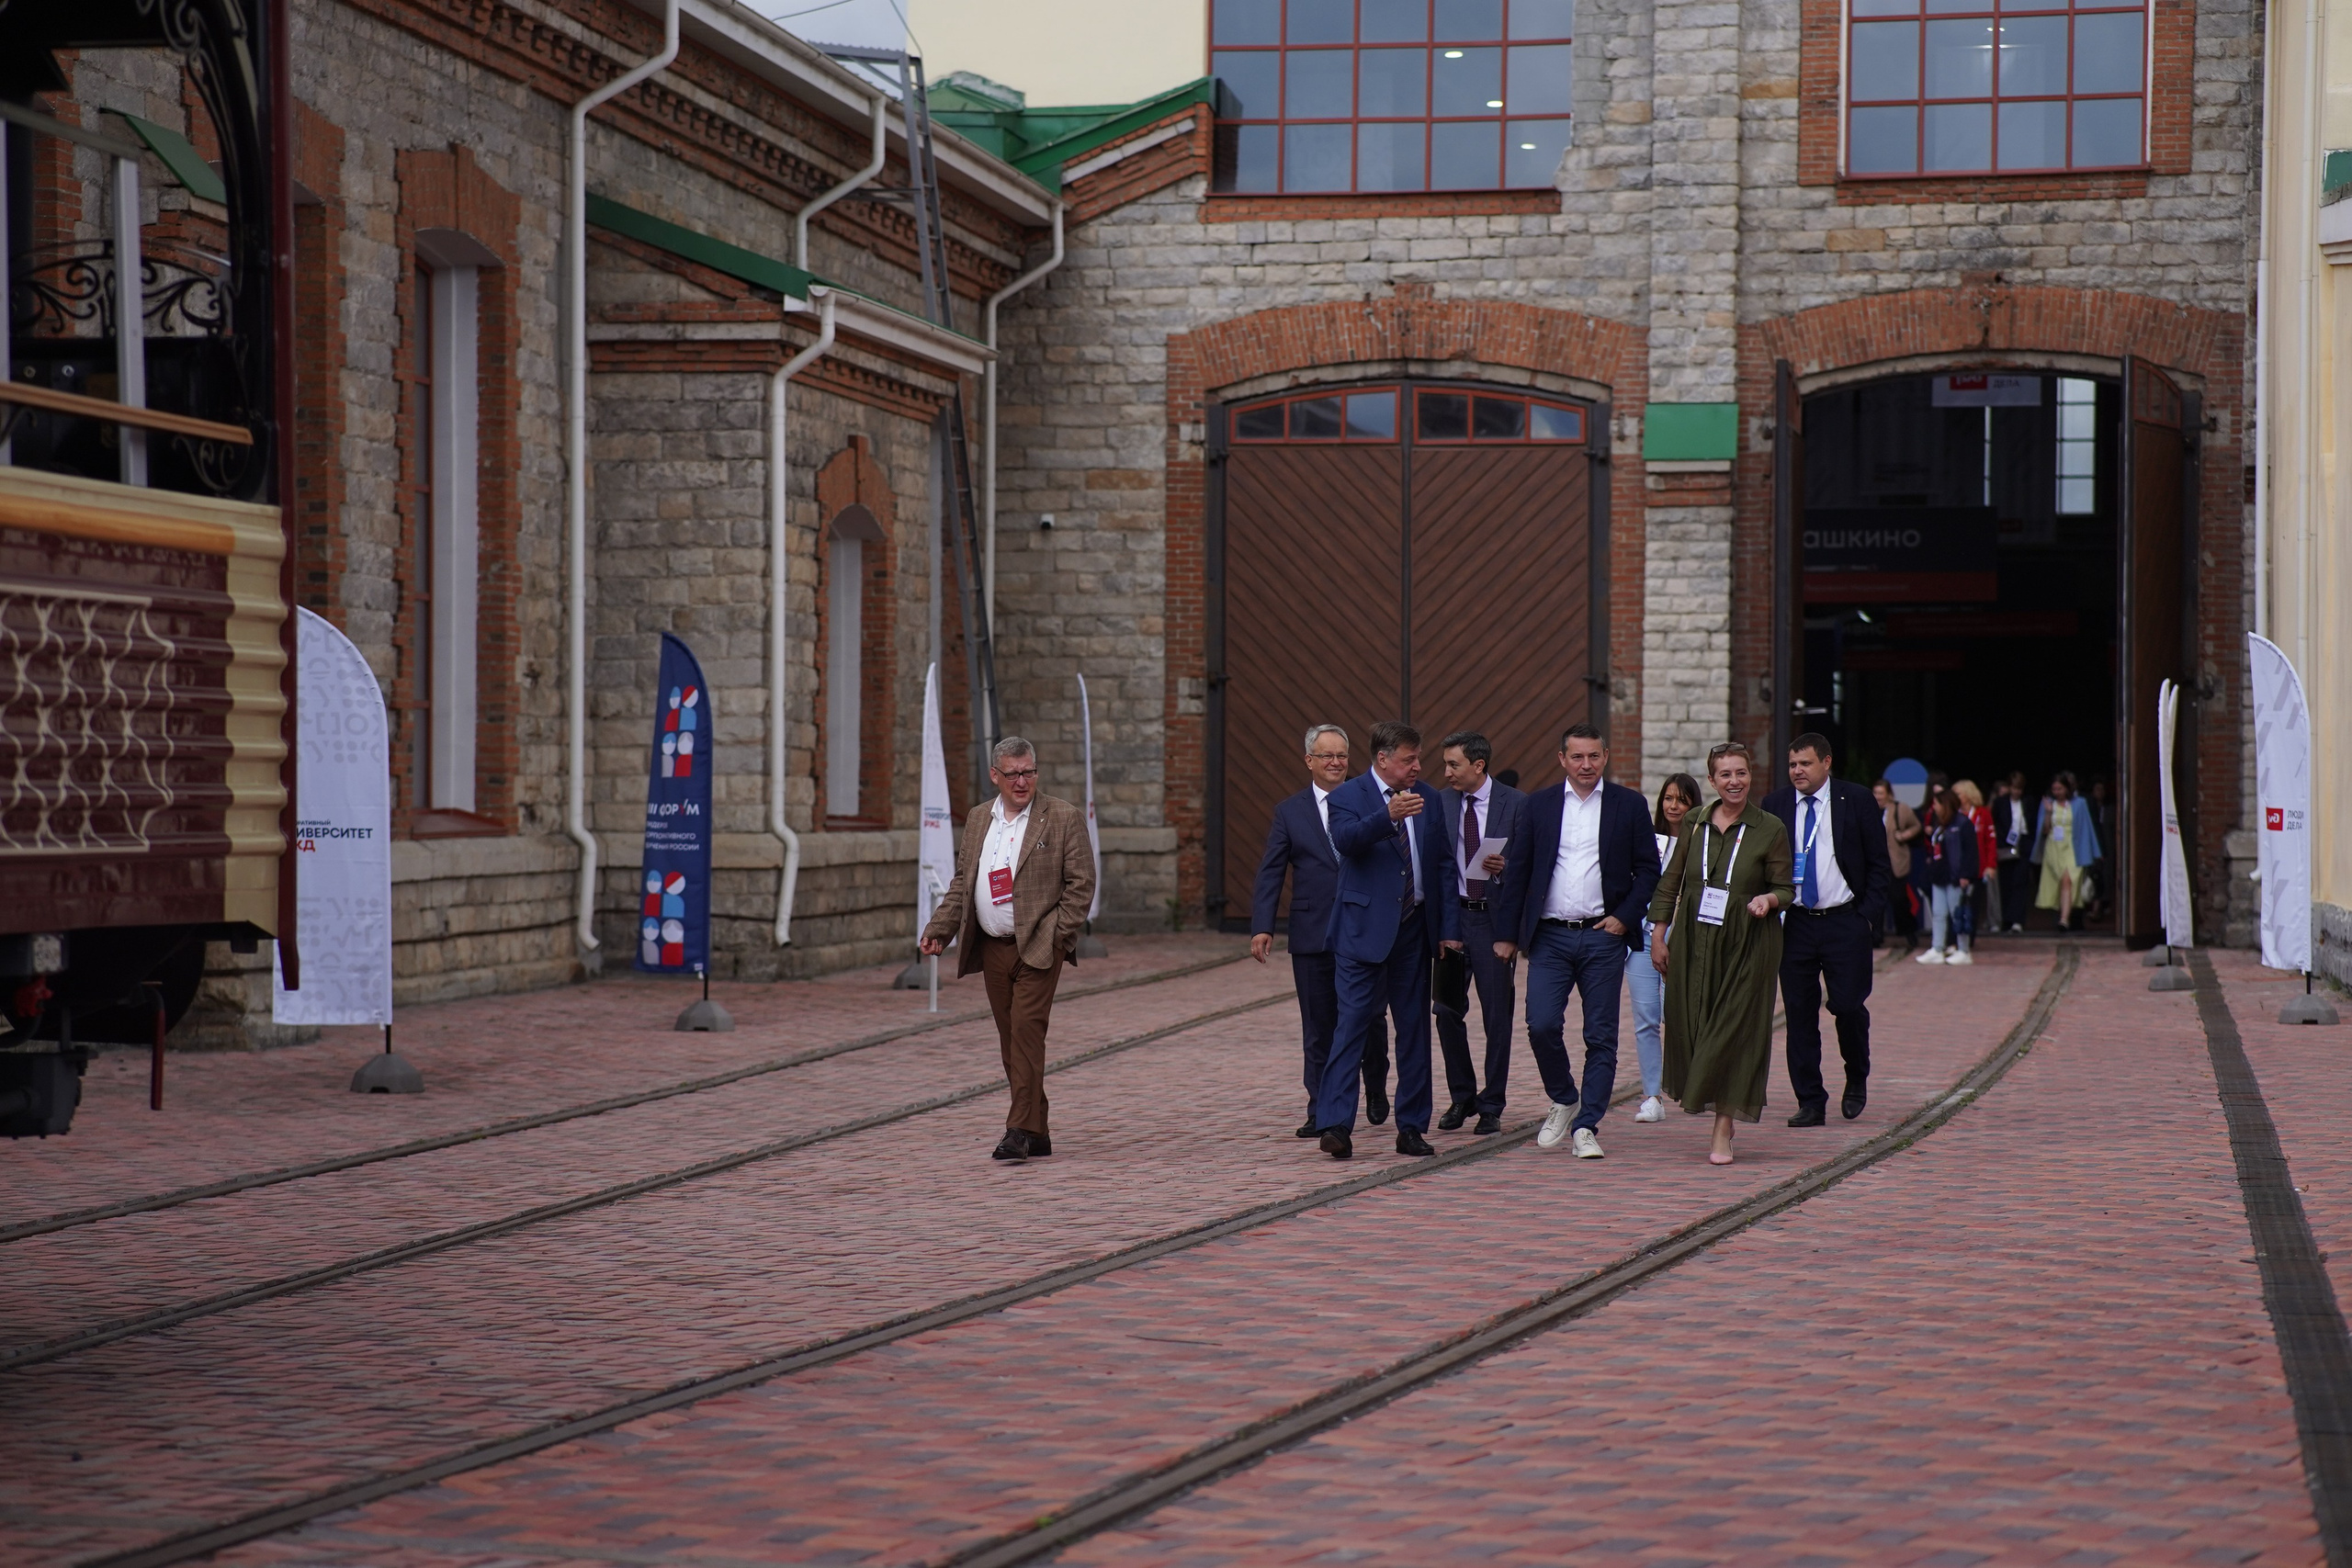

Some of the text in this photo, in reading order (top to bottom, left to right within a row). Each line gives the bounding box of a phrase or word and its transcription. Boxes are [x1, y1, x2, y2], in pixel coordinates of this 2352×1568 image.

[1993, 378, 2019, 389] ДЕЛА
[2287, 810, 2304, 819] ЛЮДИ
[2286, 821, 2303, 830] ДЕЛА
